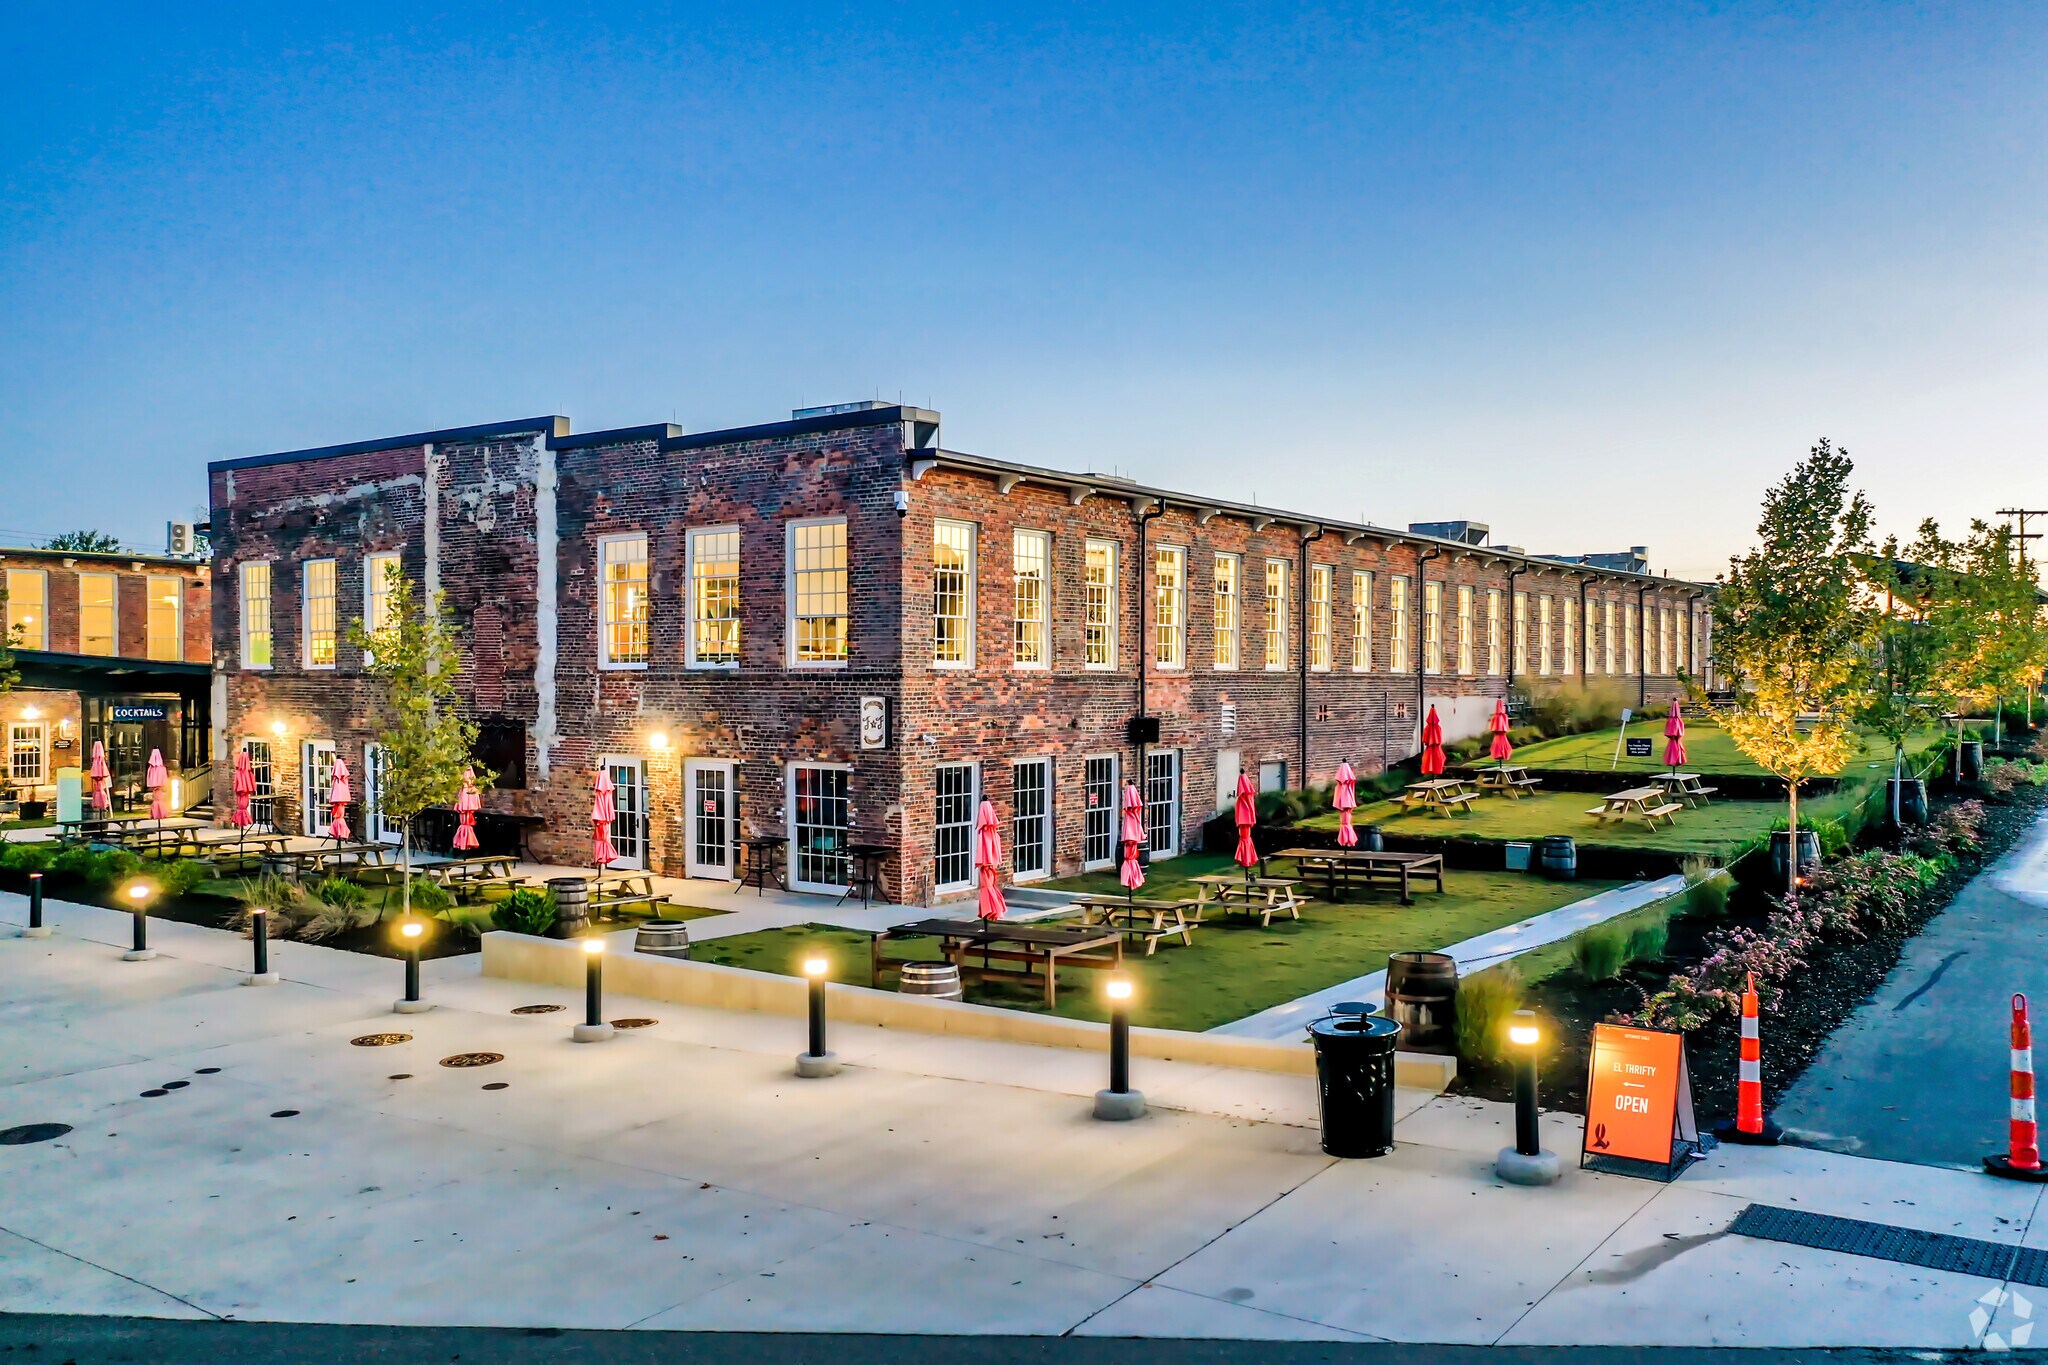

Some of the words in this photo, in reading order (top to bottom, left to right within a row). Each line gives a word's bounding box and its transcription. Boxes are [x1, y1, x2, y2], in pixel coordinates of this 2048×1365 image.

[115, 709, 163, 717] COCKTAILS
[1613, 1063, 1622, 1072] EL
[1625, 1064, 1656, 1076] THRIFTY
[1615, 1095, 1648, 1113] OPEN
